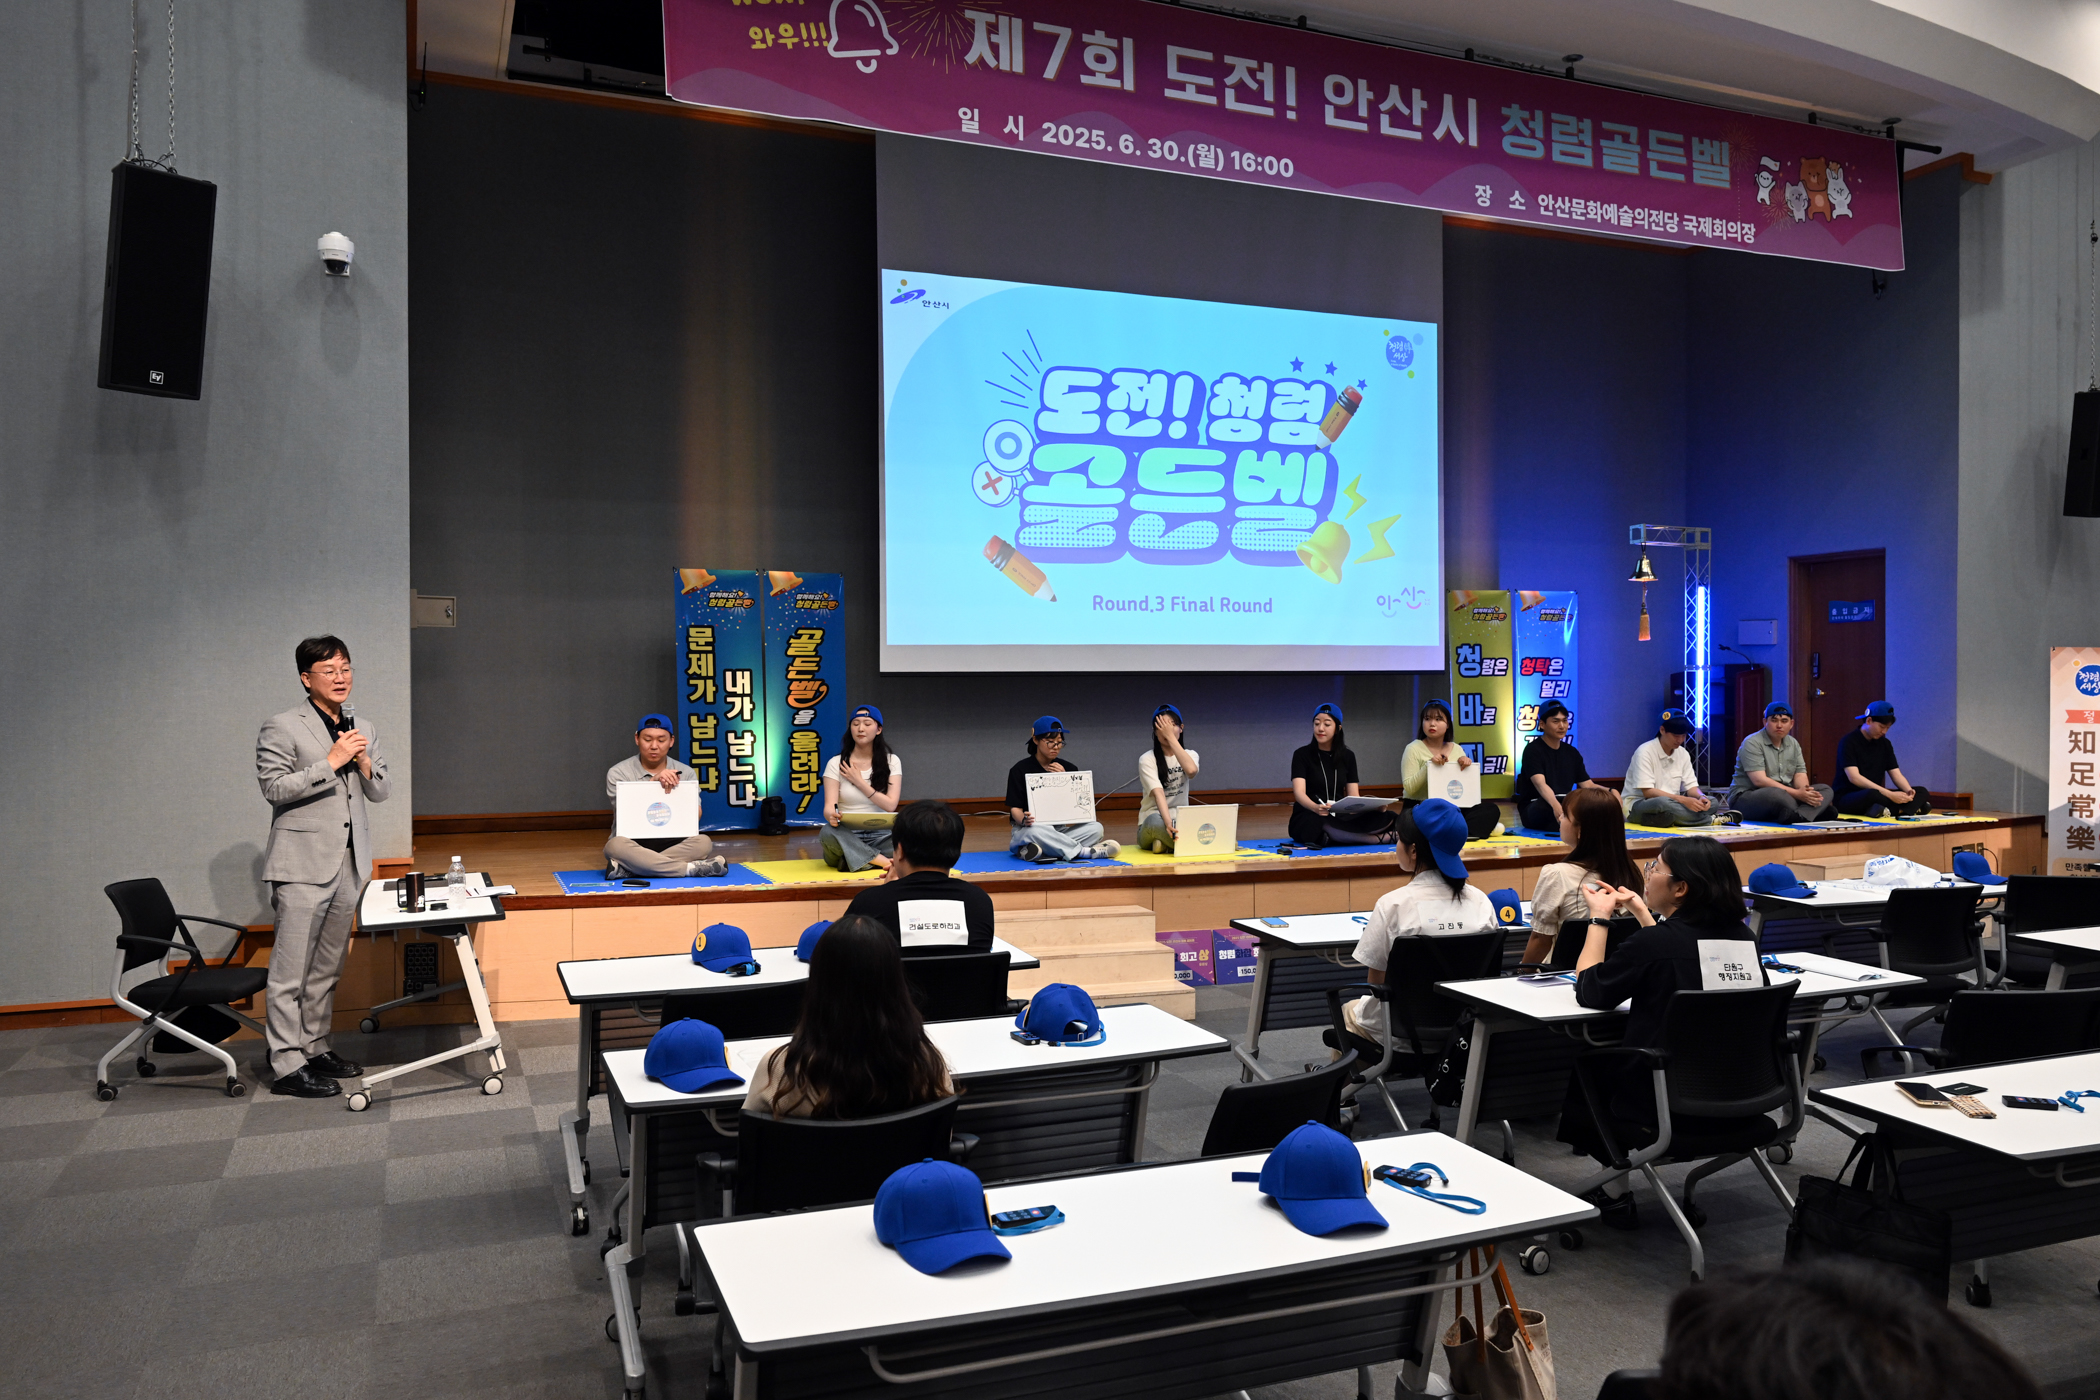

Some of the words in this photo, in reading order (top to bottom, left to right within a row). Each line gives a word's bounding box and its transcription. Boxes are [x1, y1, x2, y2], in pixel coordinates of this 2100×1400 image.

[749, 22, 829, 49] 와우!!!
[964, 9, 1135, 92] 제7회
[1164, 45, 1297, 121] 도전!
[1323, 74, 1478, 148] 안산시
[1501, 103, 1731, 189] 청렴골든벨
[1230, 151, 1294, 178] 16:00
[1538, 194, 1679, 233] 안산문화예술의전당
[1683, 214, 1756, 243] 국제회의장
[922, 300, 949, 309] 안산시
[1036, 368, 1195, 440] 도전!
[1208, 375, 1327, 446] 청렴
[1017, 442, 1328, 552] 골든벨
[1093, 595, 1165, 613] Round.3
[1171, 596, 1215, 612] Final
[1220, 597, 1273, 613] Round
[688, 627, 716, 703] 문제가
[787, 629, 828, 725] 골든벨을
[1457, 644, 1508, 676] 청렴은
[1521, 658, 1564, 675] 청탁은
[725, 671, 753, 720] 내가
[1459, 694, 1497, 725] 바로
[1540, 681, 1571, 698] 멀리
[690, 715, 719, 791] 남느냐
[727, 732, 756, 806] 남느냐
[790, 732, 821, 813] 울려라!
[2067, 729, 2096, 850] 知足常樂
[1504, 909, 1511, 919] 4
[1718, 972, 1752, 981] 행정지원과
[1724, 963, 1743, 972] 단원구
